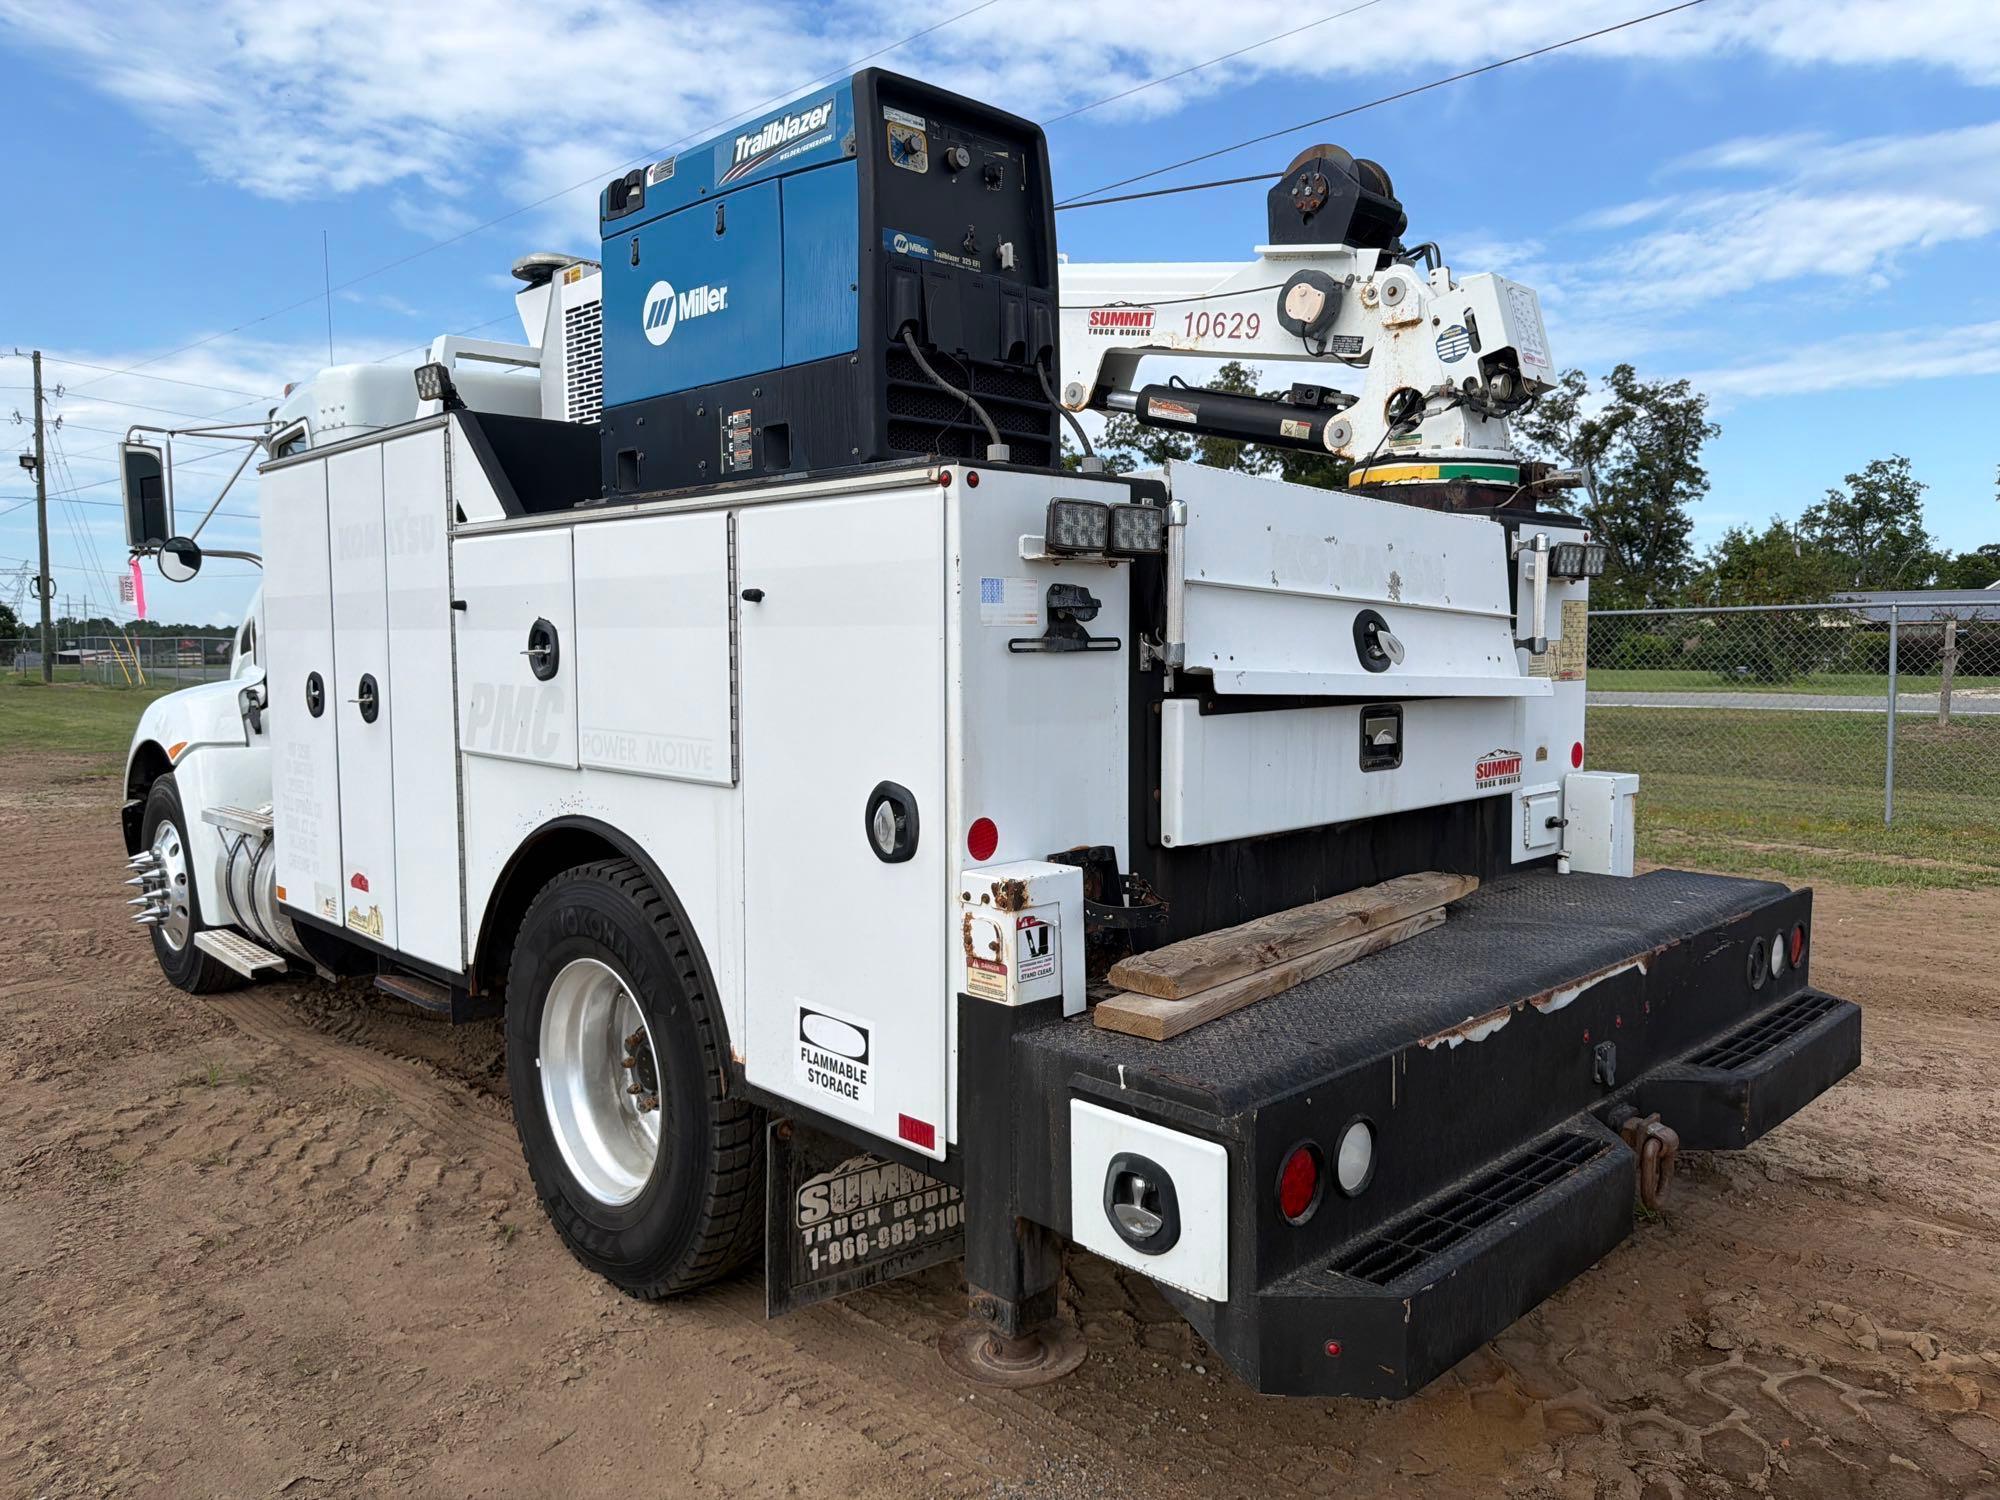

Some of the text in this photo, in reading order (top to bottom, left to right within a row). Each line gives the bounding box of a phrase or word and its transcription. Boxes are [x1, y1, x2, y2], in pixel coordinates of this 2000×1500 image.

[733, 101, 833, 164] Trailblazer
[909, 243, 929, 255] Miller
[933, 250, 960, 263] Trailblazer
[678, 286, 728, 321] Miller
[1089, 310, 1155, 328] SUMMIT
[1088, 328, 1151, 337] TRUCK BODIES
[1184, 311, 1261, 340] 10629
[465, 683, 564, 759] PMC
[581, 731, 714, 771] POWER MOTIVE
[1476, 758, 1522, 779] SUMMIT
[1476, 775, 1521, 790] TRUCK BODIES
[1021, 967, 1052, 980] STAND CLEAR
[801, 1046, 867, 1085] FLAMMABLE
[807, 1067, 859, 1101] STORAGE
[800, 1164, 942, 1223] SUMM
[802, 1185, 962, 1246] TRUCK BODIE
